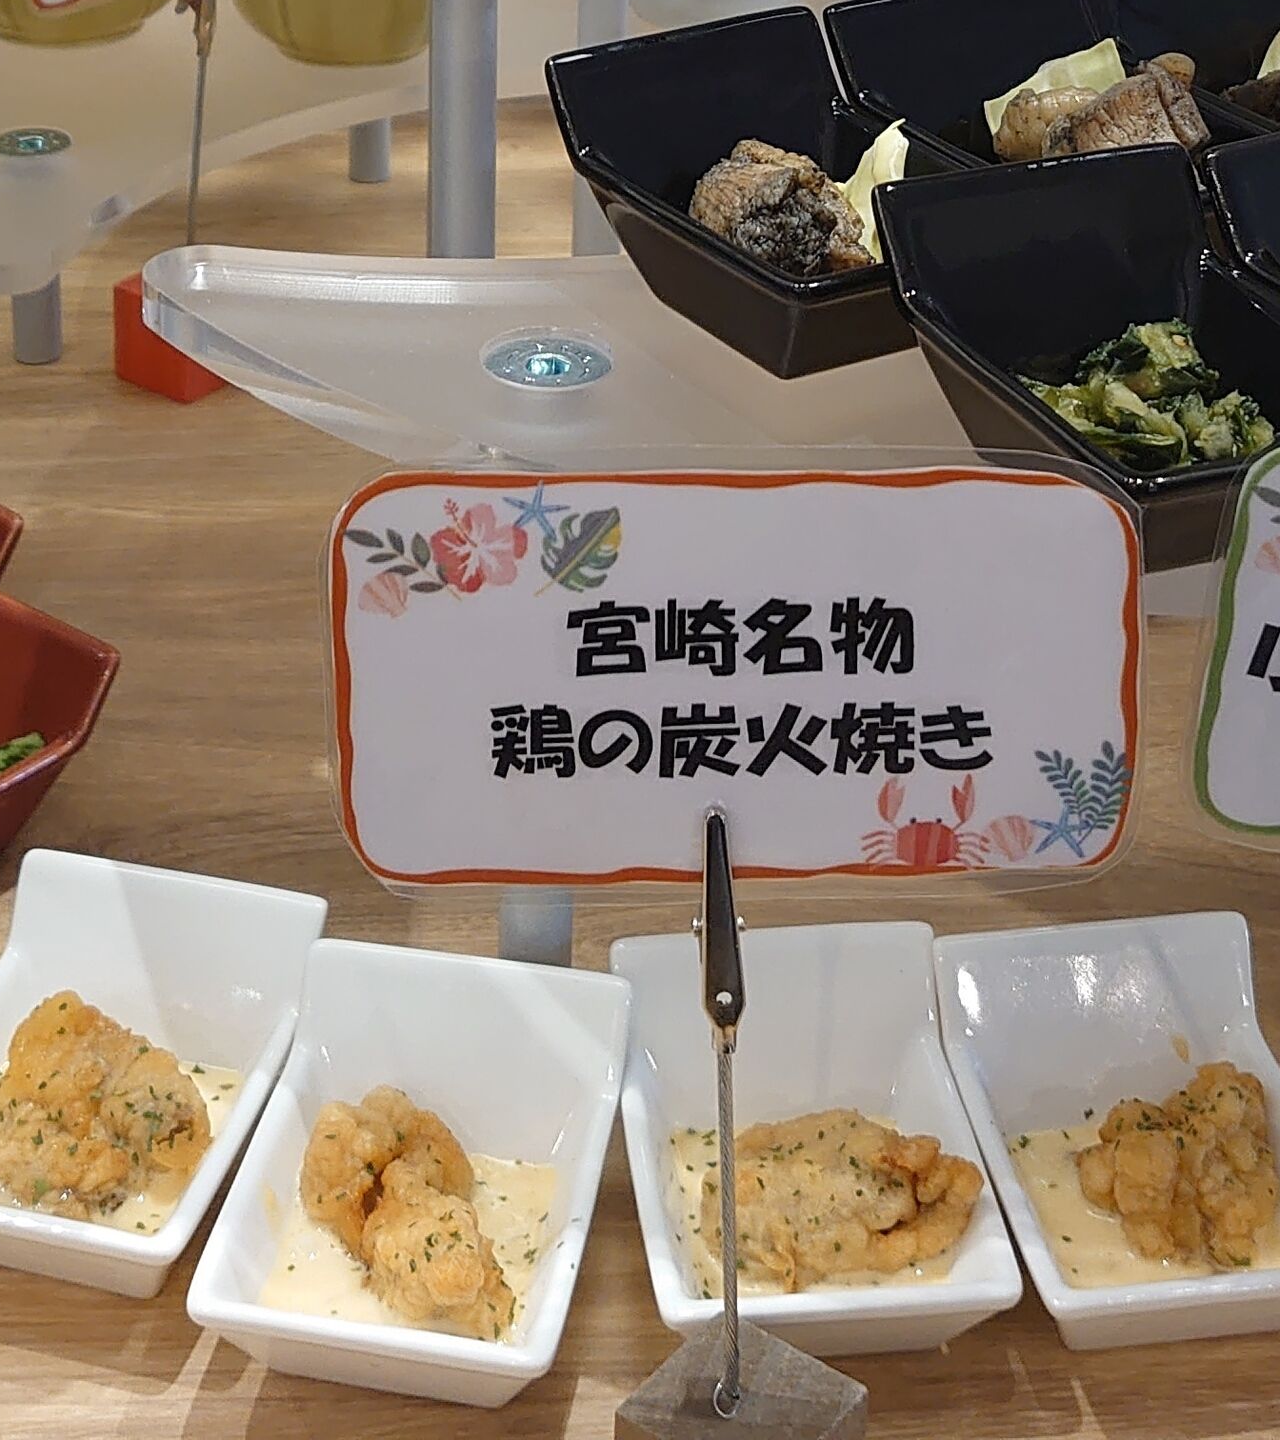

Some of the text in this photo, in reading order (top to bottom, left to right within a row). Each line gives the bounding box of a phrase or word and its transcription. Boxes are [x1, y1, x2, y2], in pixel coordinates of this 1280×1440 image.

[565, 595, 915, 678] 宮崎名物
[489, 701, 994, 779] 鶏の炭火焼き
